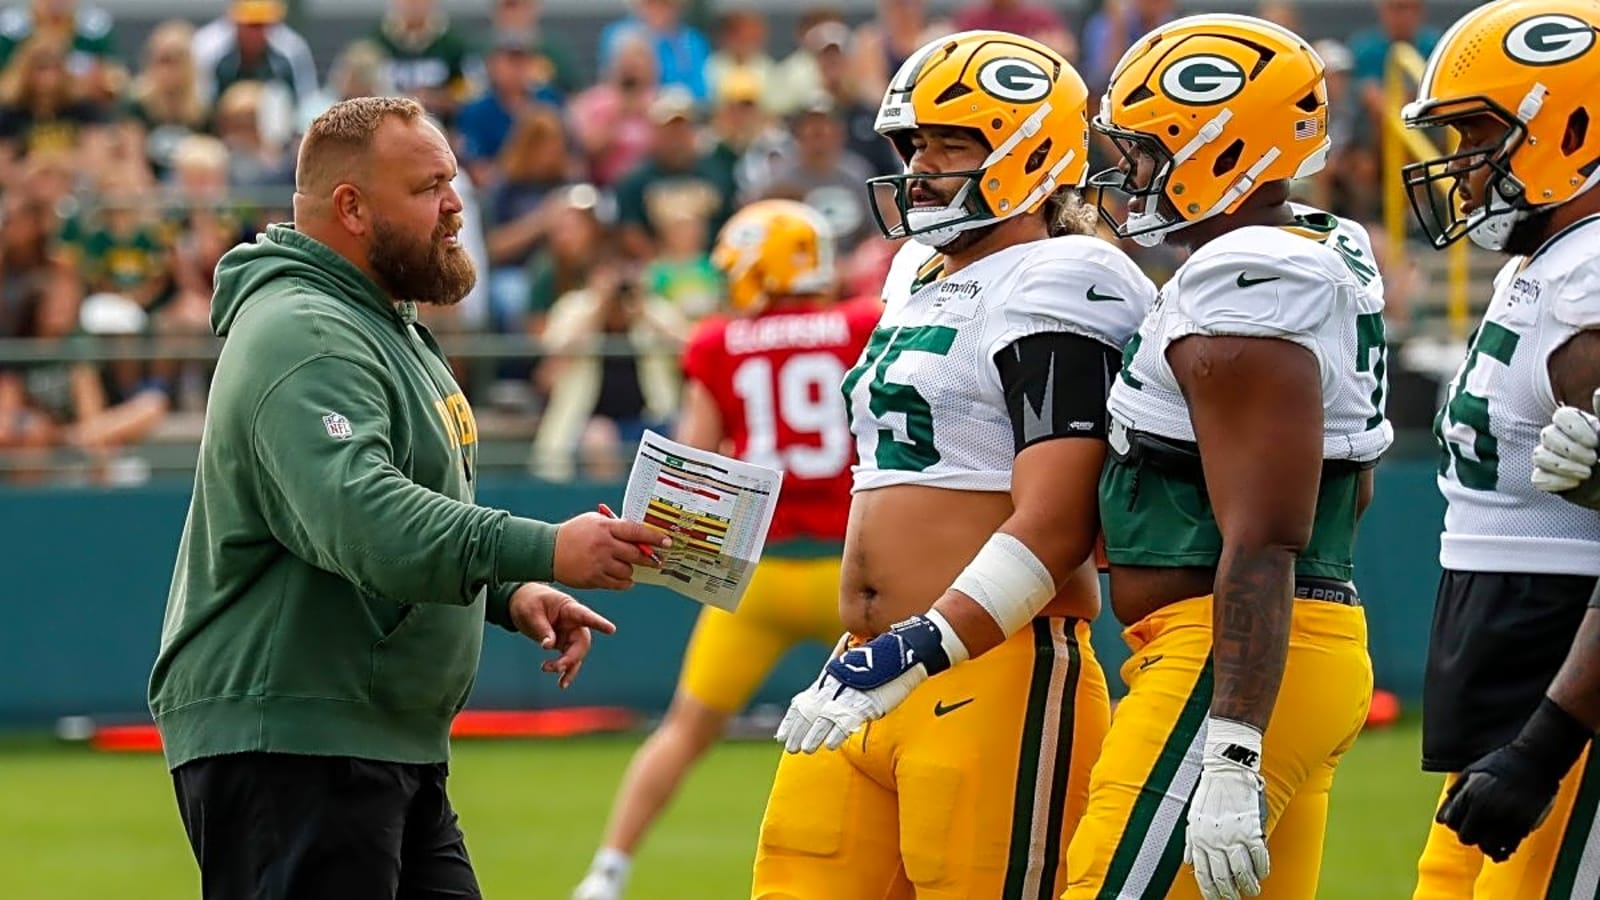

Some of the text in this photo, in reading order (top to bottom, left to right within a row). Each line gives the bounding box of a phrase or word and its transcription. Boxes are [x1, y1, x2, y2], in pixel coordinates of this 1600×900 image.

[977, 57, 1052, 103] G
[1161, 54, 1245, 105] G
[732, 351, 851, 480] 19
[841, 325, 958, 472] 75
[329, 423, 351, 434] NFL
[1312, 588, 1345, 603] PRO
[1221, 743, 1259, 768] NIKE
